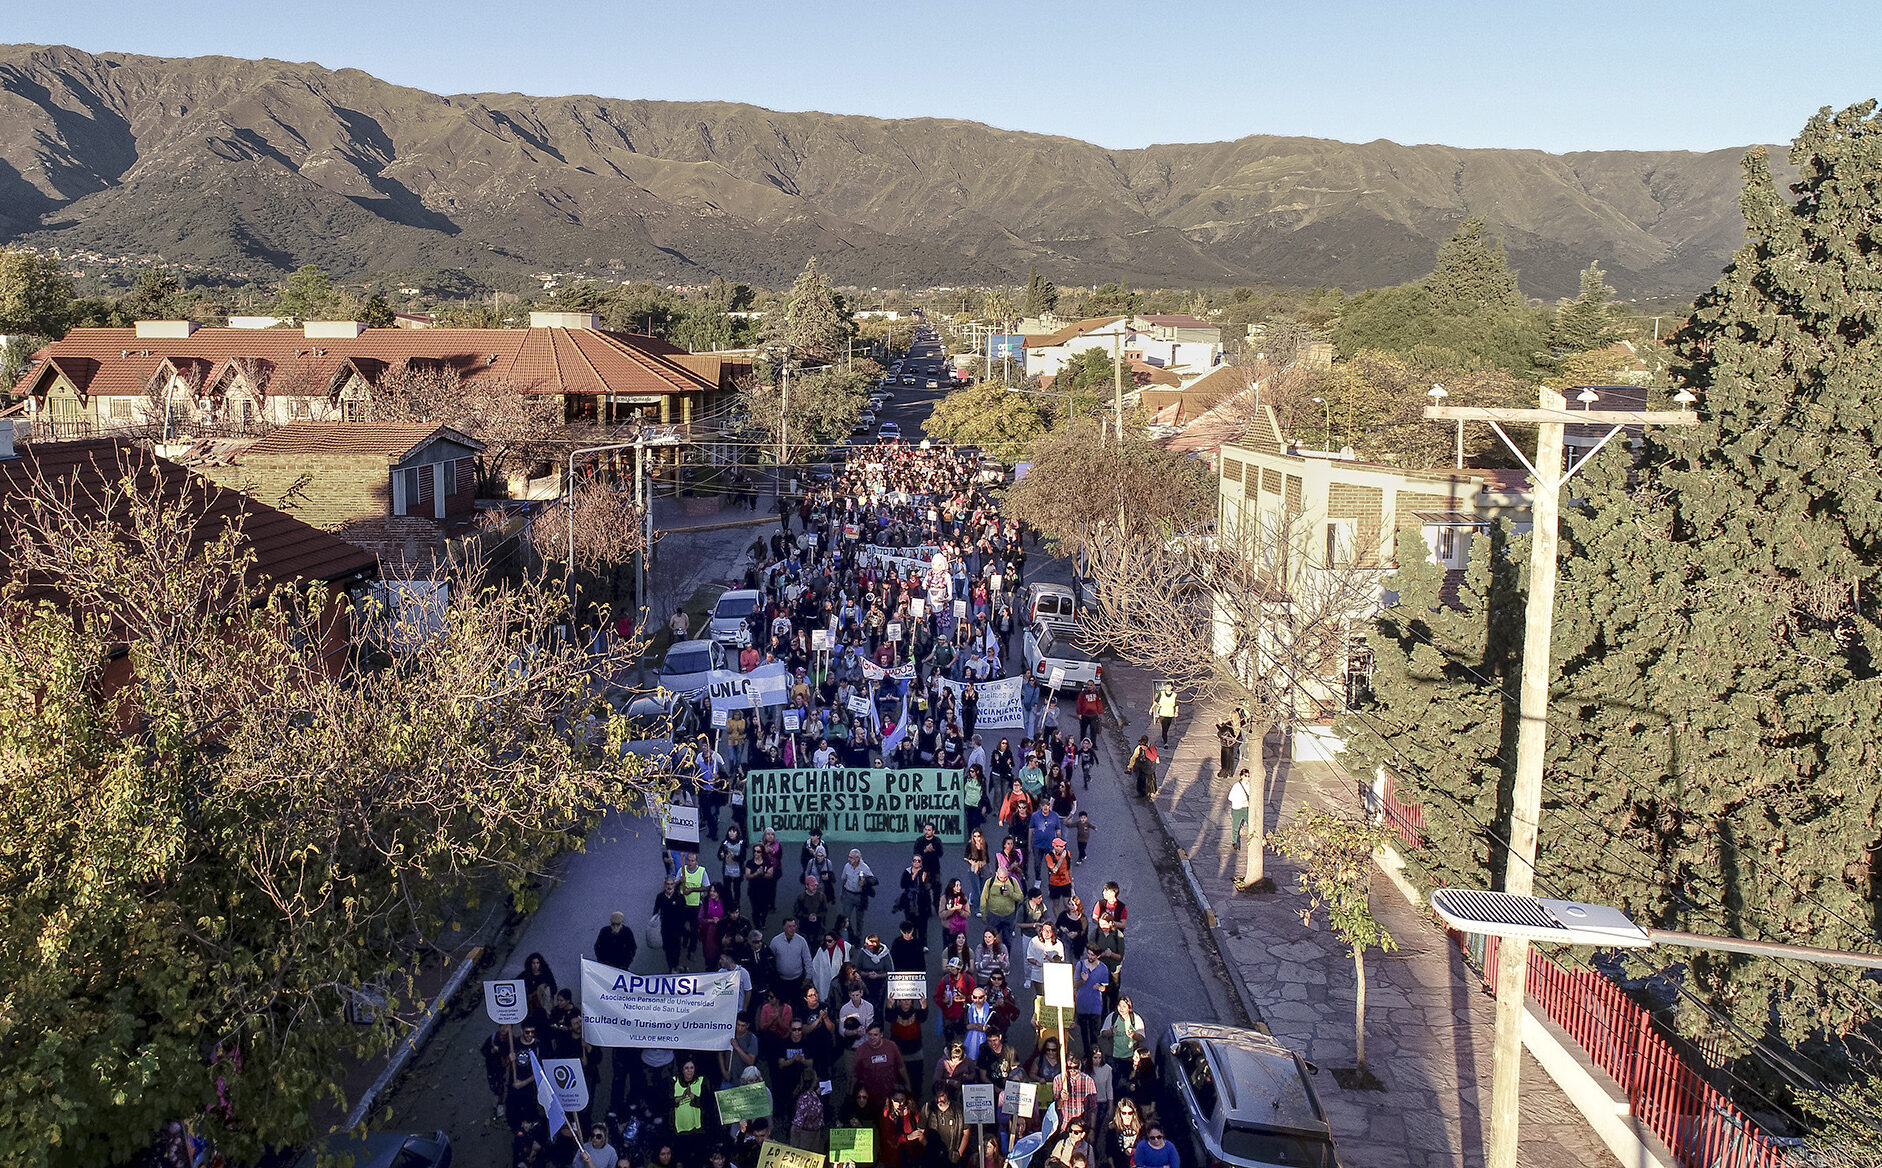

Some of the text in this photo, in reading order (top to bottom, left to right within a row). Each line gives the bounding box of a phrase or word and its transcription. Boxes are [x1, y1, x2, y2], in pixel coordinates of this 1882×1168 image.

[710, 679, 751, 698] UNLC
[979, 692, 1006, 701] xigimos
[751, 771, 961, 794] MARCHAMOS POR LA
[752, 793, 900, 813] UNIVERSIDAD
[752, 810, 962, 835] LA EDUCACIÓN Y LA CIENCIA NACIONAL
[612, 974, 705, 996] APUNSL
[600, 993, 636, 1002] Asociación
[637, 996, 666, 1004] Personal
[676, 998, 714, 1007] Universidad
[623, 1003, 652, 1011] Nacional
[620, 1015, 631, 1026] de
[634, 1019, 672, 1029] Turismo
[673, 1021, 680, 1030] y
[682, 1021, 733, 1030] Urbanismo
[767, 1147, 780, 1157] LO
